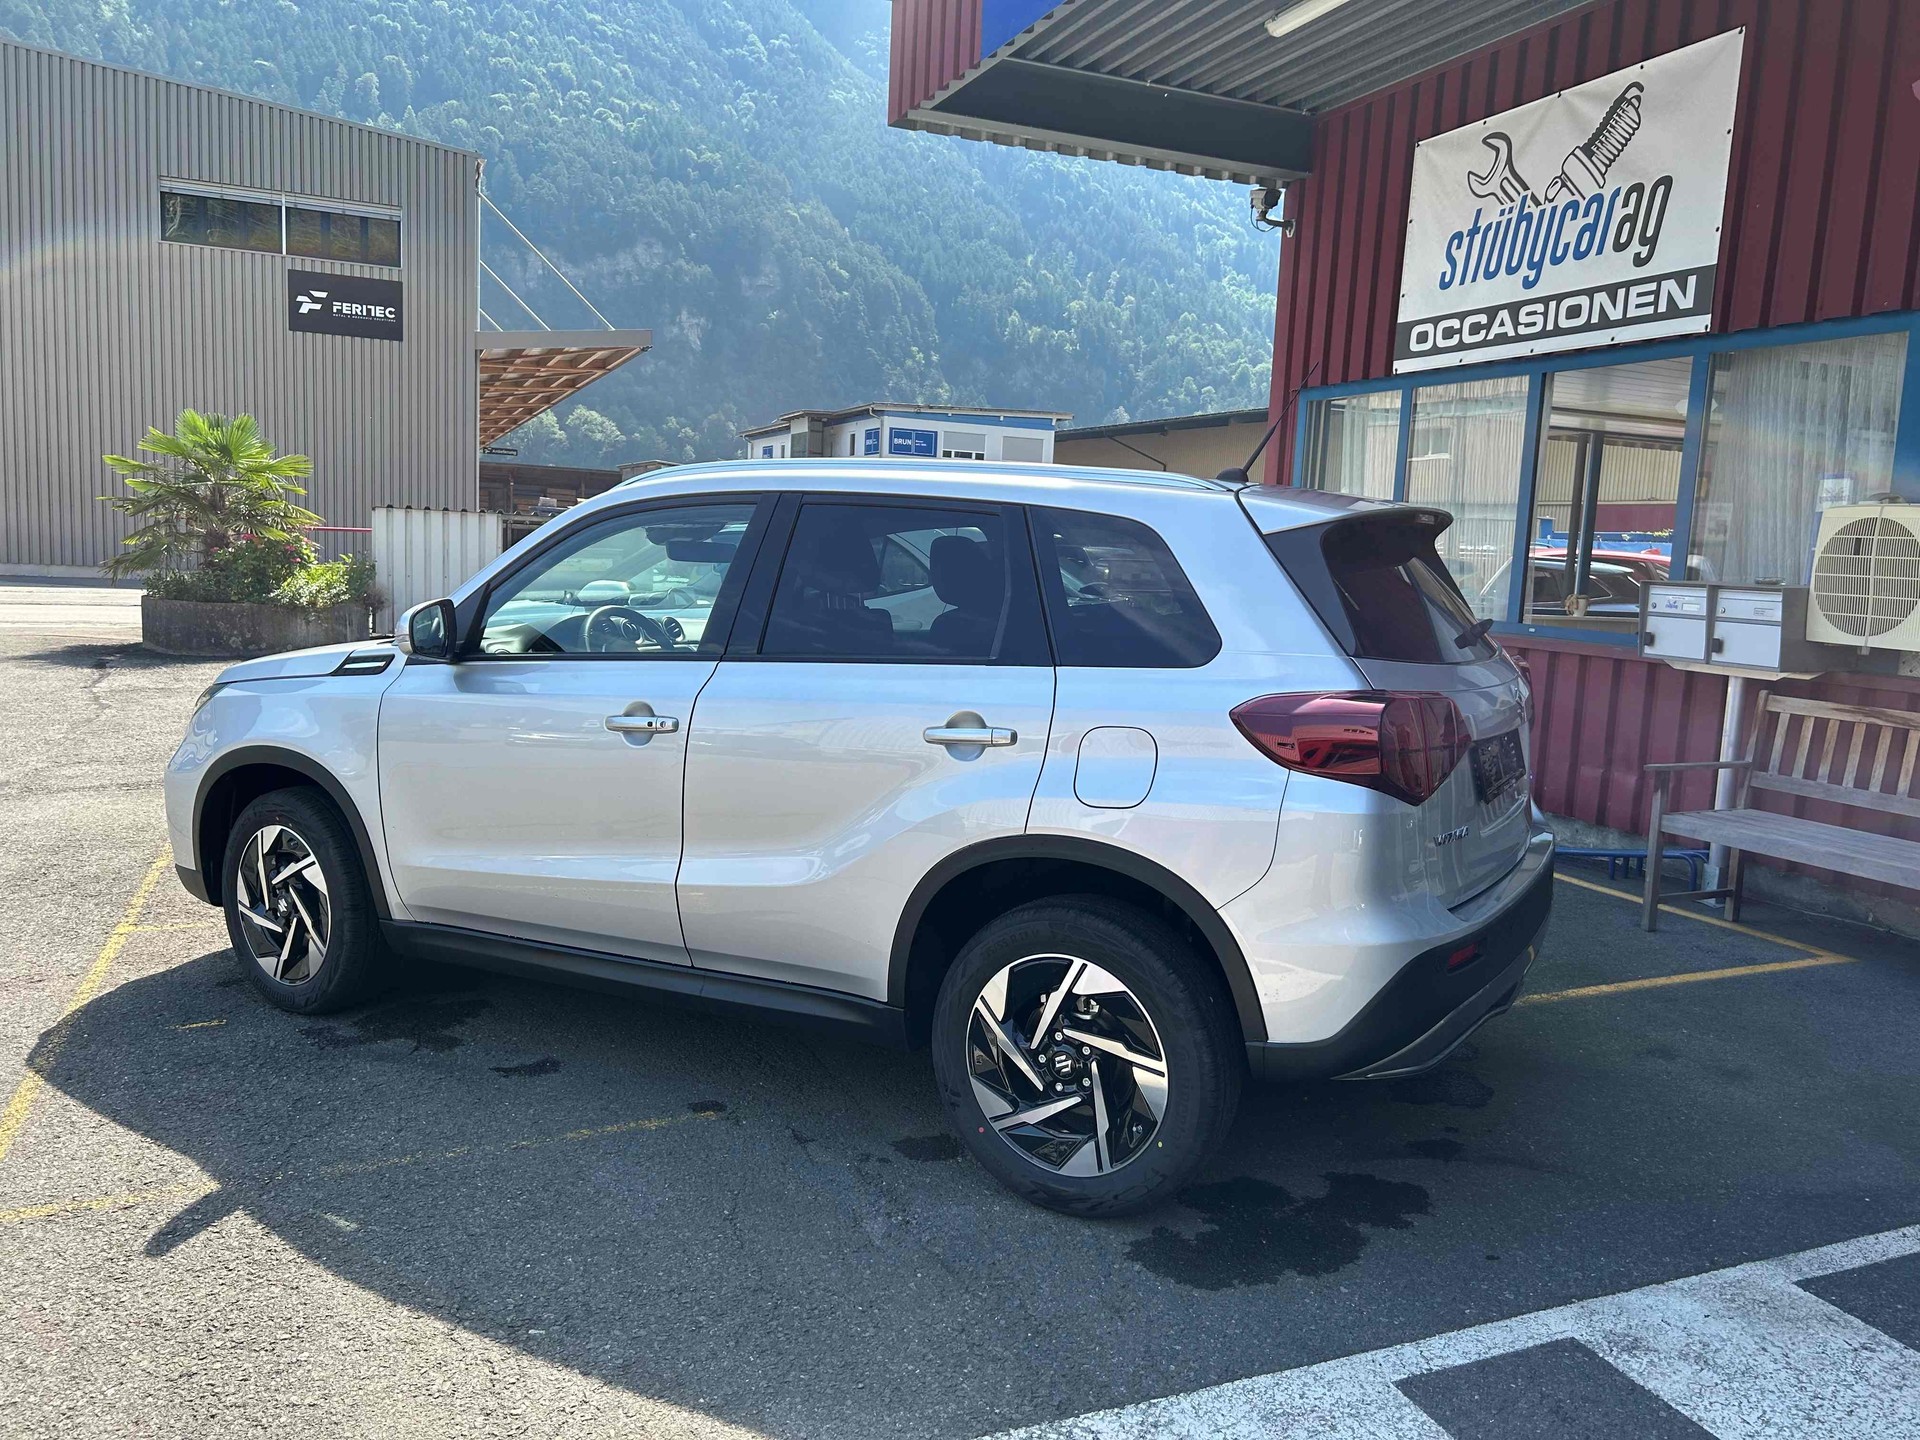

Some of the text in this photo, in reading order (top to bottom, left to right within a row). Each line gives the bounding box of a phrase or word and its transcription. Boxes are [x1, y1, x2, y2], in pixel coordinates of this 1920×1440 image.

[332, 302, 396, 318] FERITEC
[1408, 274, 1698, 352] OCCASIONEN
[893, 437, 912, 446] BRUN
